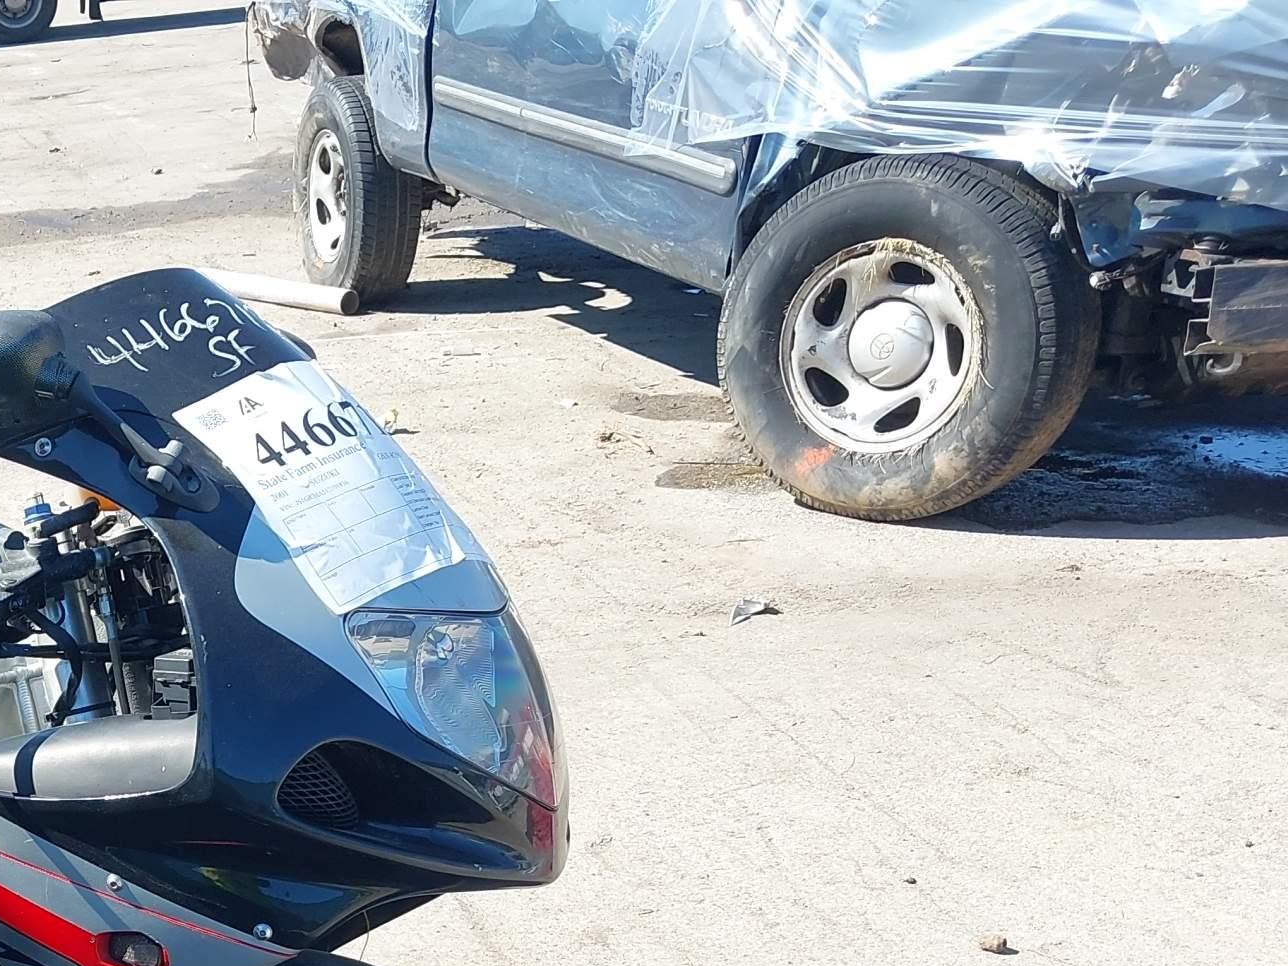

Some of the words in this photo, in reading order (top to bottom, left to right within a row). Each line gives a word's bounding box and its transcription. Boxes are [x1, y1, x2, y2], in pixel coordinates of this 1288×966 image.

[208, 329, 257, 378] SF
[257, 472, 289, 491] State
[286, 462, 317, 480] Farm
[316, 442, 367, 467] Insurance
[308, 468, 341, 486] SUZUKI
